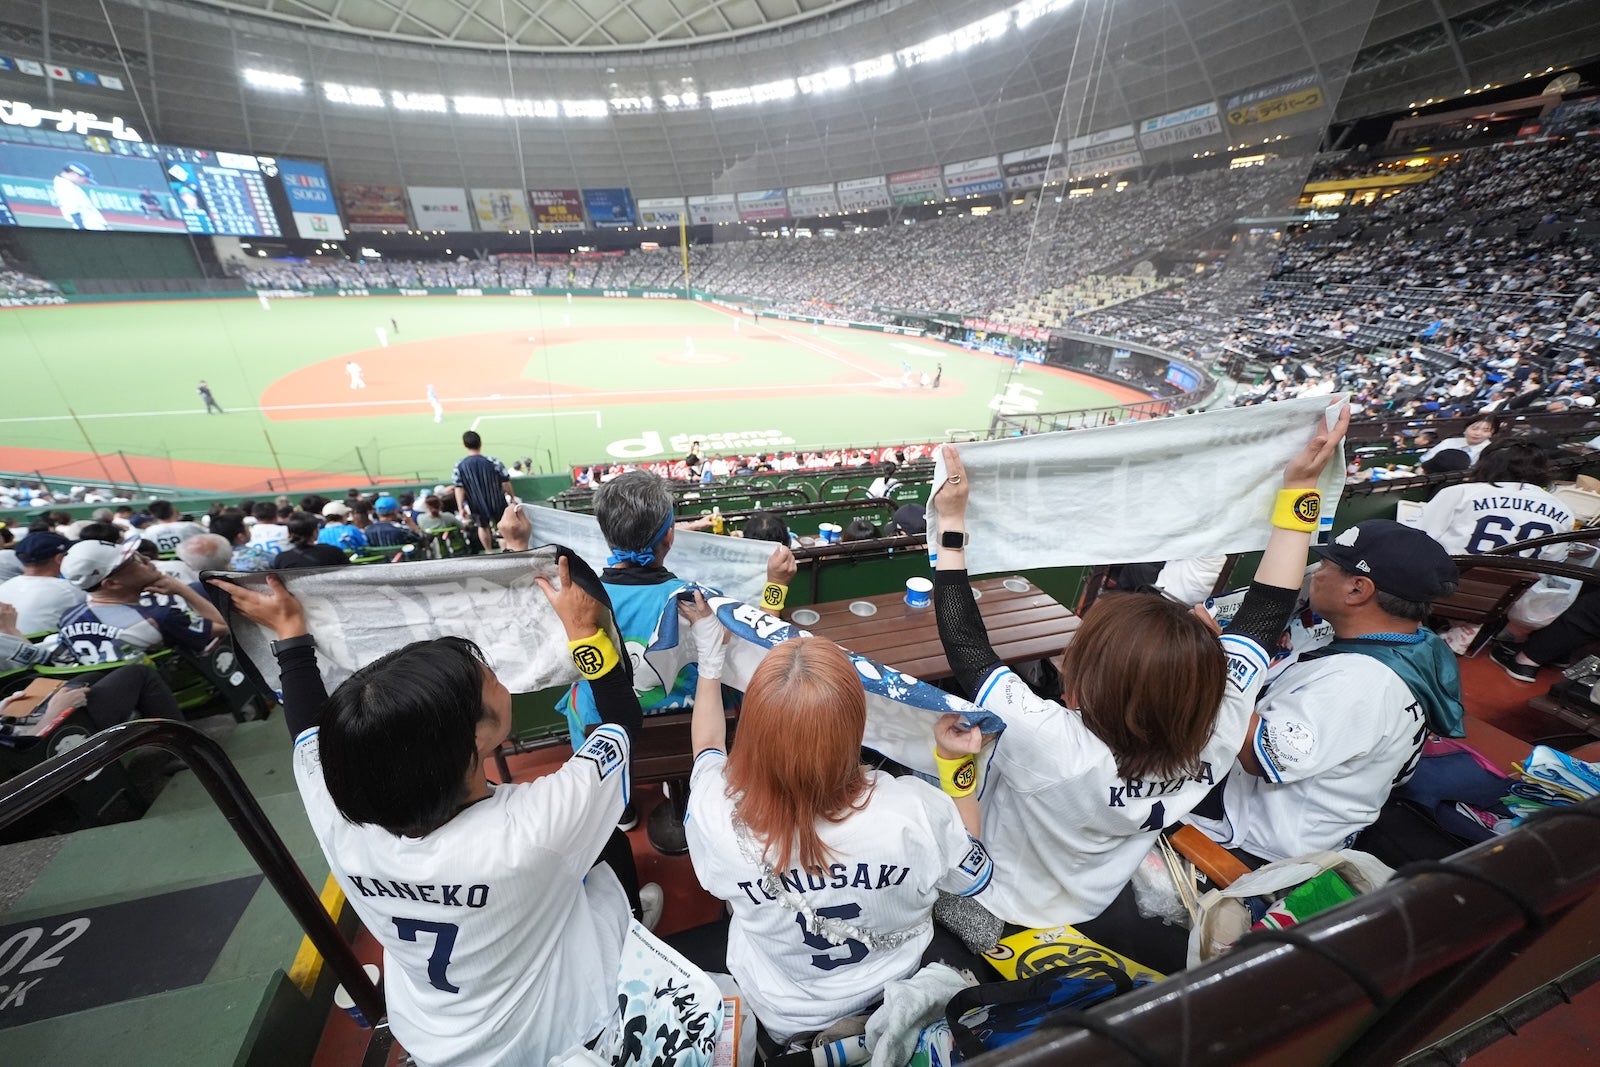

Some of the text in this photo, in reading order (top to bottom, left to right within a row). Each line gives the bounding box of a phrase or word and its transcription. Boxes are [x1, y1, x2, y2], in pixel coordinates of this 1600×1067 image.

[965, 181, 1004, 194] AMANO
[843, 198, 889, 210] HITACHI
[669, 429, 783, 444] docomo
[671, 435, 796, 453] business
[1473, 497, 1569, 524] MIZUKAMI
[594, 739, 617, 764] ONE
[347, 875, 490, 908] KANEKO
[796, 902, 870, 971] 5
[391, 916, 460, 994] 7
